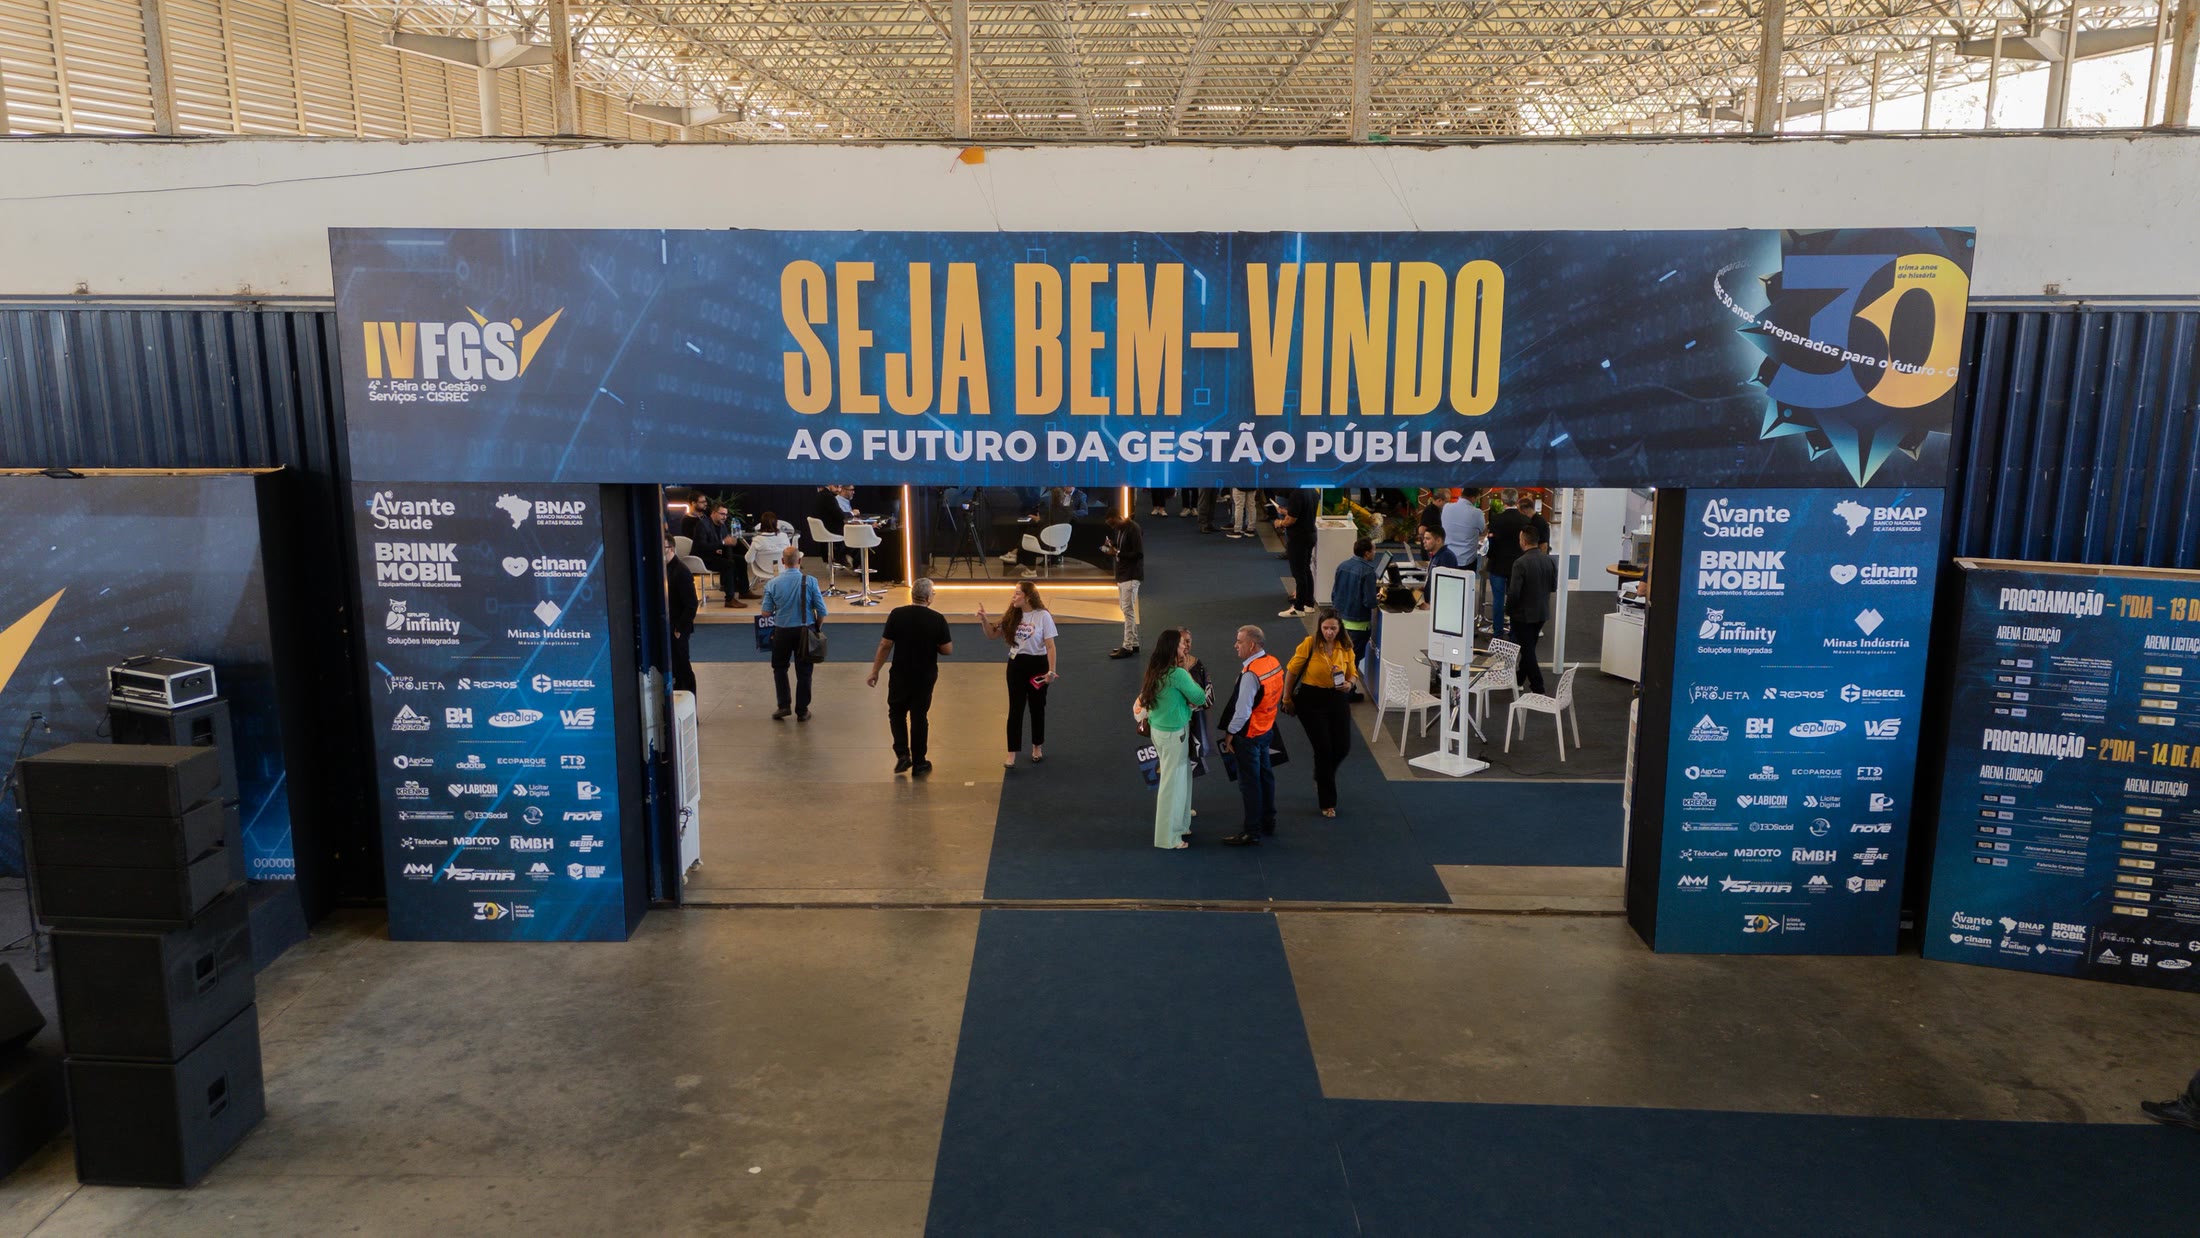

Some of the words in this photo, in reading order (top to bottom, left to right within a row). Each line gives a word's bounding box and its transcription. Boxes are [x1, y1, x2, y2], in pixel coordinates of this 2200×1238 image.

[780, 260, 990, 415] SEJA
[1732, 304, 1756, 324] anos
[1763, 320, 1839, 357] Preparados
[1841, 349, 1875, 367] para
[1878, 358, 1888, 368] o
[1892, 360, 1935, 376] futuro
[391, 381, 418, 391] Feira
[421, 381, 436, 391] de
[439, 381, 478, 391] Gestão
[369, 391, 417, 404] Serviços
[426, 392, 469, 402] CISREC
[787, 429, 852, 461] AO
[863, 429, 1037, 462] FUTURO
[1047, 430, 1109, 462] DA
[1118, 423, 1296, 463] GESTÃO
[1306, 423, 1495, 463] PÚBLICA
[535, 501, 586, 514] BNAP
[1874, 507, 1928, 520] BNAP
[375, 542, 458, 562] BRINK
[532, 556, 587, 570] cinam
[1700, 551, 1786, 570] BRINK
[377, 562, 461, 582] MOBIL
[1861, 563, 1918, 578] cinam
[1698, 570, 1785, 590] MOBIL
[2000, 588, 2104, 618] PROGRAMAÇÃO
[2170, 598, 2187, 621] 13
[406, 618, 460, 635] infinity
[508, 629, 541, 639] Minas
[543, 629, 591, 639] Indústria
[1720, 626, 1776, 644] infinity
[1996, 626, 2020, 640] ARENA
[2022, 627, 2061, 644] EDUCAÇÃO
[387, 637, 420, 646] Soluções
[422, 637, 460, 645] Integradas
[1823, 638, 1858, 648] Minas
[1860, 638, 1910, 648] Indústria
[2144, 635, 2169, 650] ARENA
[1698, 646, 1732, 655] Soluções
[1733, 646, 1773, 654] Integradas
[391, 682, 445, 690] PROJETA
[553, 680, 596, 688] ENGECEL
[1694, 691, 1750, 700] PROJETA
[1862, 690, 1906, 698] ENGECEL
[445, 708, 472, 724] BH
[1746, 718, 1774, 733] BH
[1982, 728, 2085, 760] PROGRAMAÇÃO
[2152, 743, 2169, 766] 14
[2170, 744, 2189, 767] DE
[1980, 765, 2004, 780] ARENA
[2005, 767, 2043, 784] EDUCAÇÃO
[464, 784, 498, 794] LABICON
[2124, 778, 2149, 793] ARENA
[2151, 780, 2189, 797] LICITAÇÃO
[1753, 795, 1788, 806] LABICON
[510, 838, 554, 849] RMBH
[1792, 850, 1836, 862] RMBH
[2018, 922, 2045, 930] BNAP
[2052, 922, 2087, 933] BRINK
[1964, 935, 1992, 944] cinam
[2052, 931, 2086, 940] MOBIL
[2008, 942, 2031, 952] infinity
[2131, 953, 2148, 963] BH
